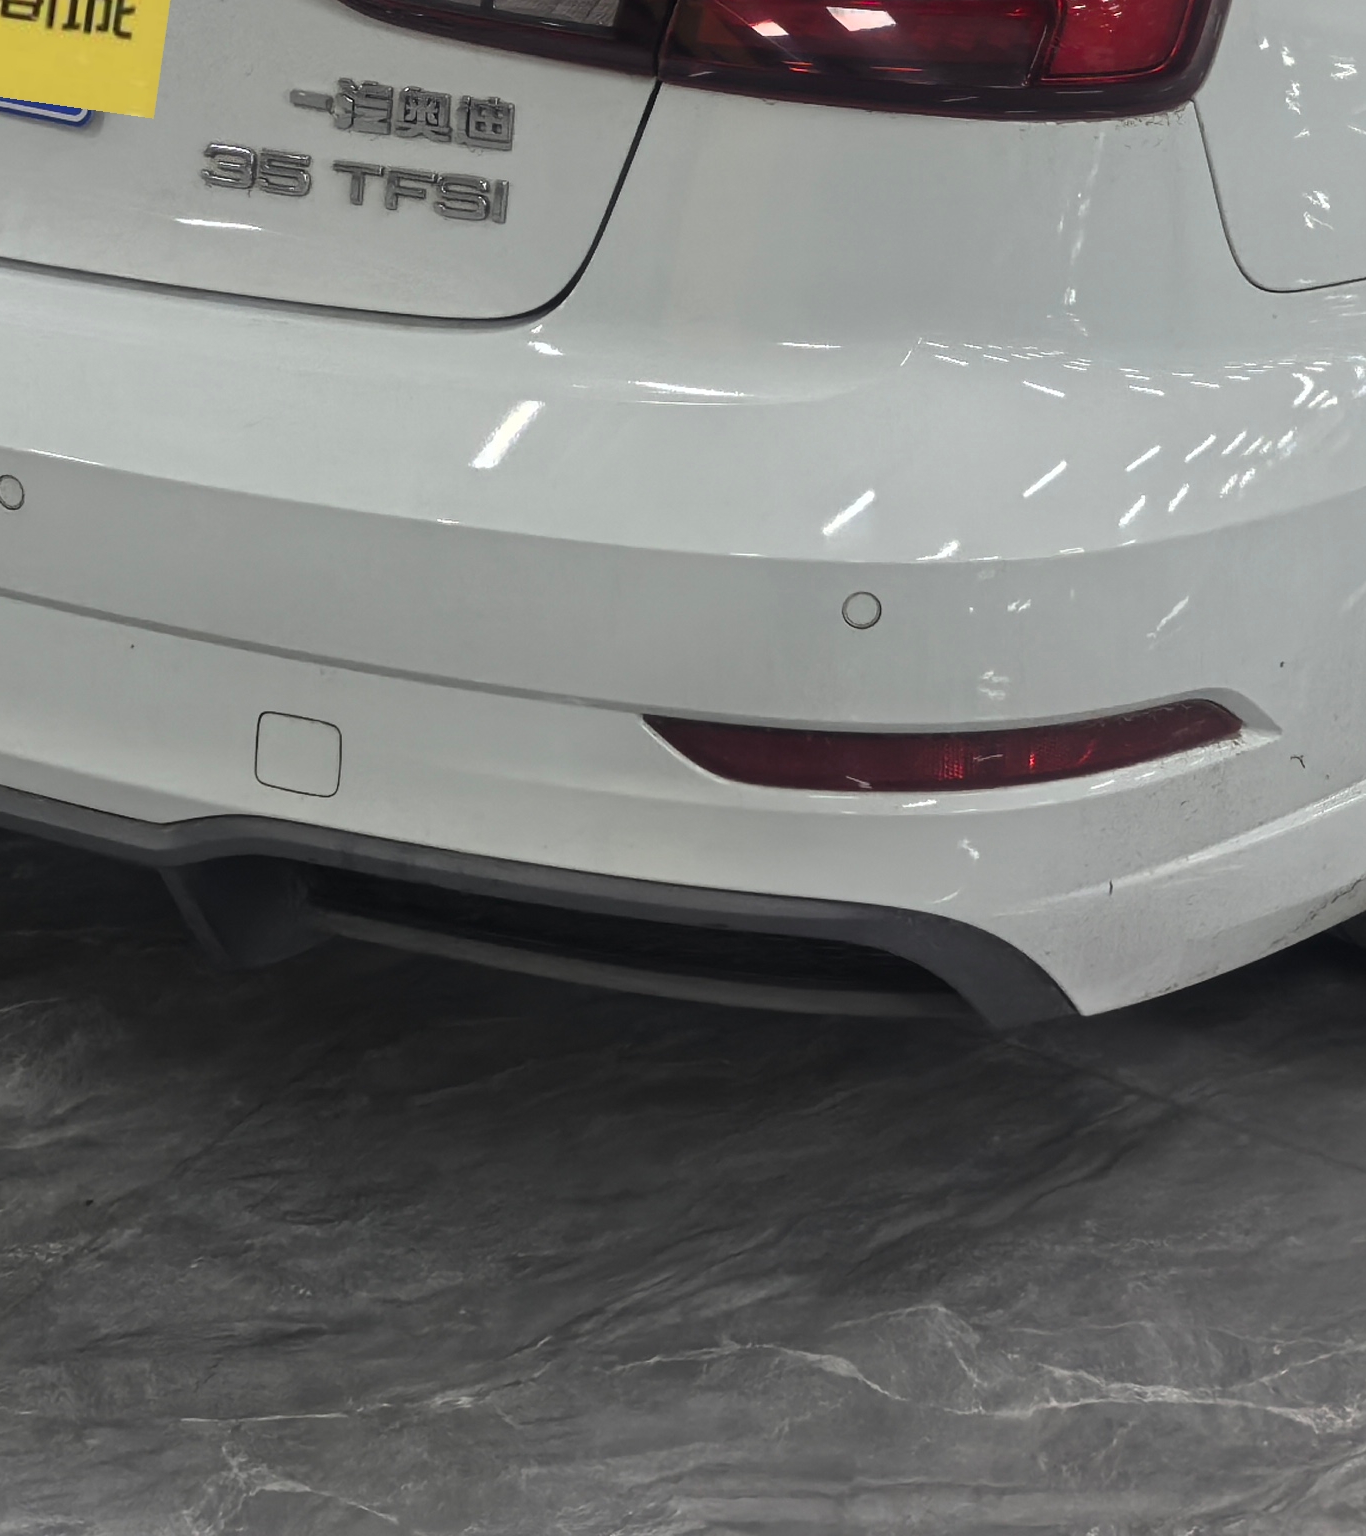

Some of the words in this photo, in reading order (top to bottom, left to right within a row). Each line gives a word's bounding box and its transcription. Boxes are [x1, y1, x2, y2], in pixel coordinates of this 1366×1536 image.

[289, 77, 516, 151] 一汽奥迪
[201, 142, 312, 198] 35
[332, 160, 510, 224] TFSI
